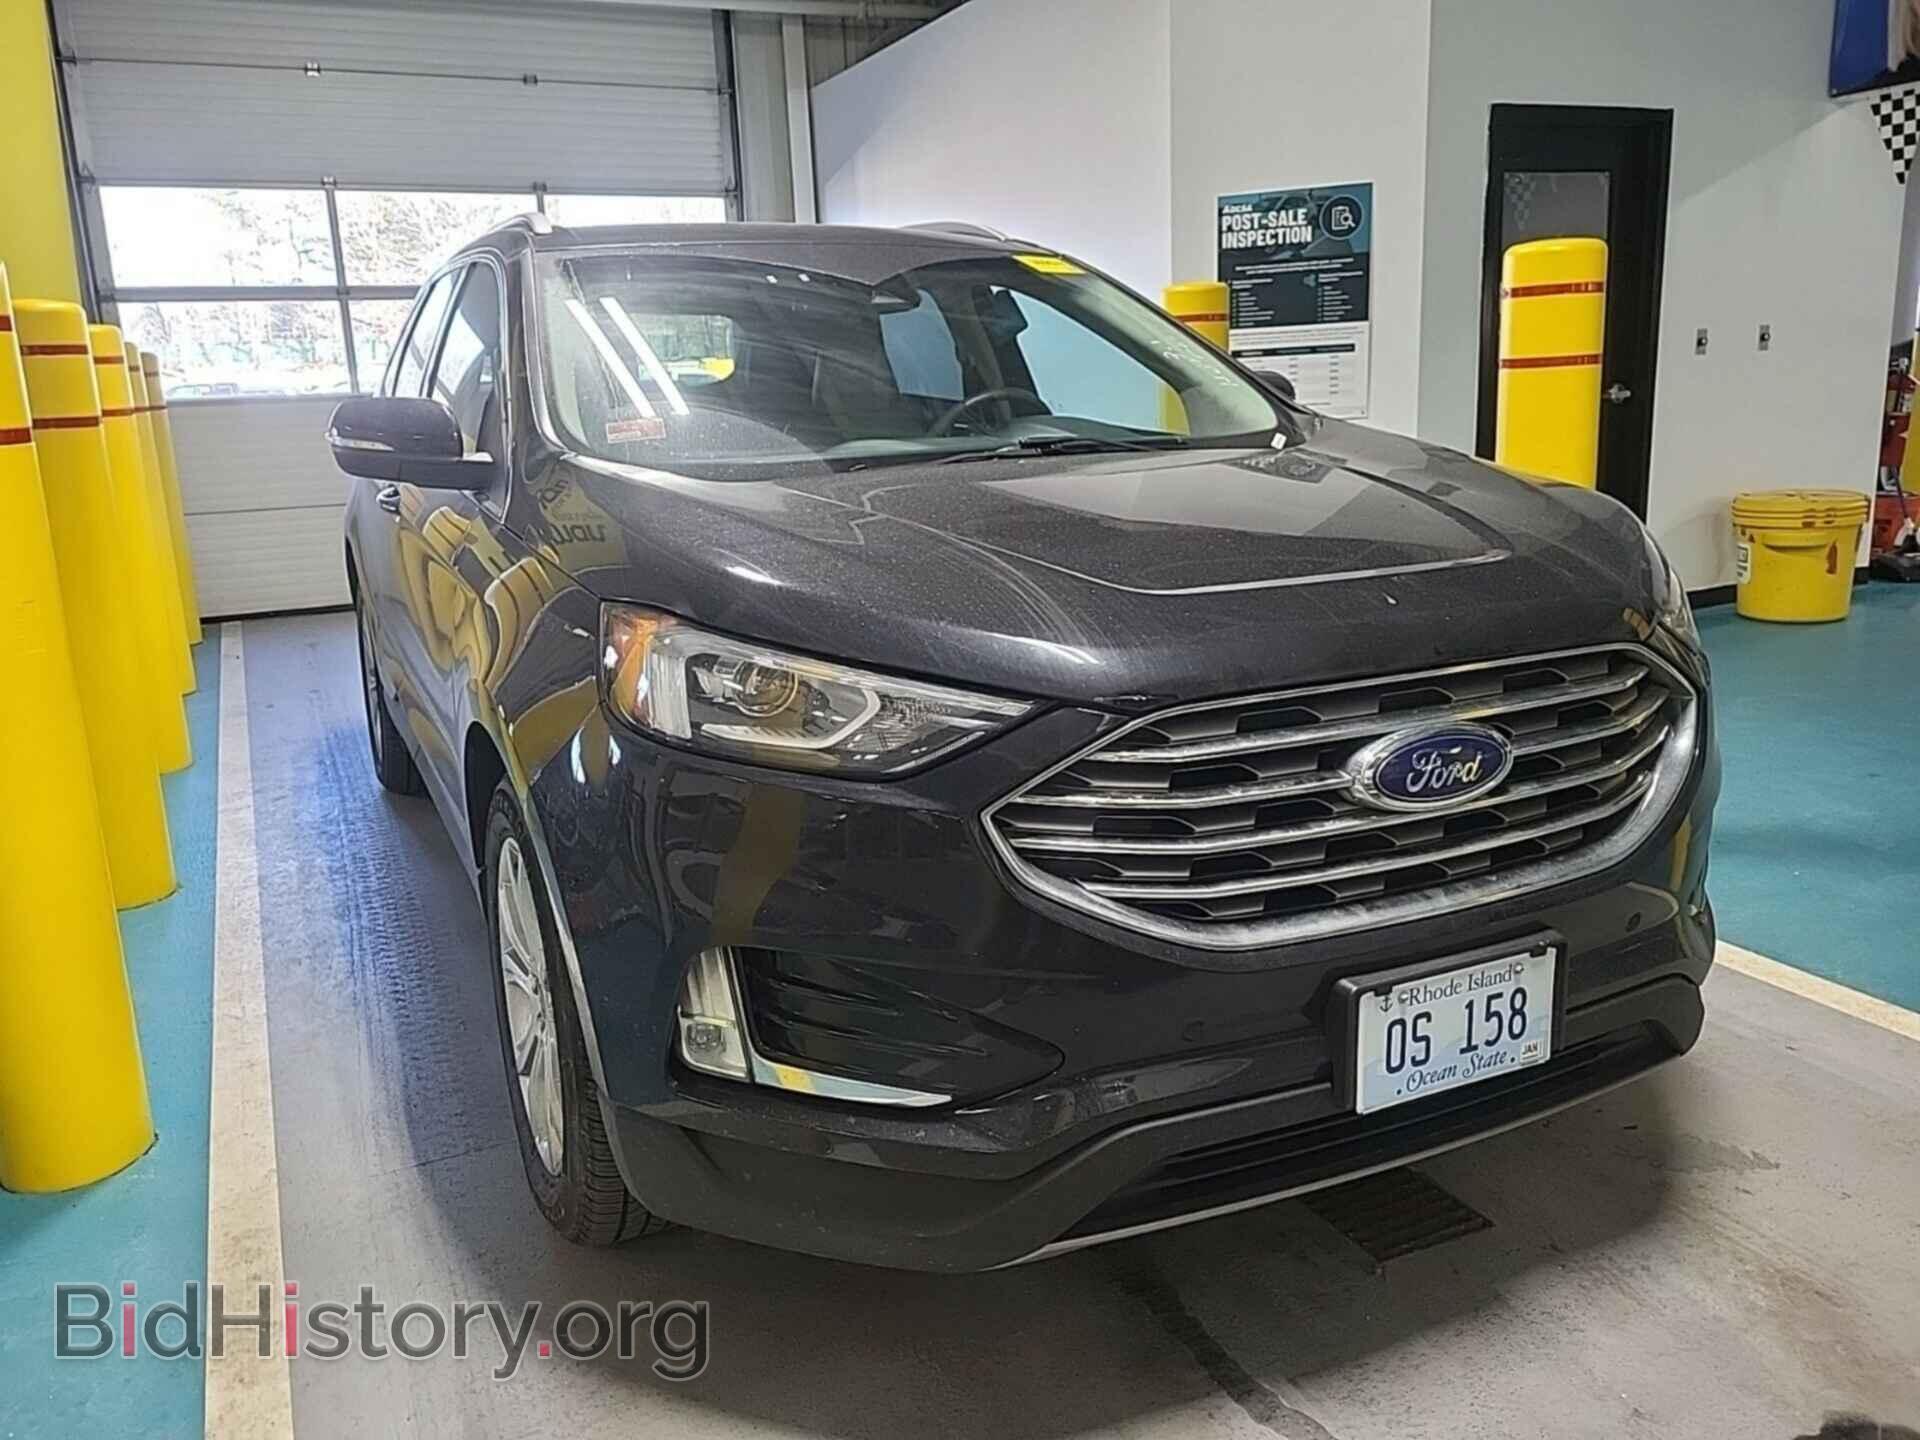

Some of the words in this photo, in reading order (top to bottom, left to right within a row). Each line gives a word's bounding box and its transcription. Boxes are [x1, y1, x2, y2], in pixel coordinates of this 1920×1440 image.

[1222, 208, 1308, 231] POST-SALE
[1222, 225, 1312, 249] INSPECTION
[1406, 747, 1483, 792] Ford
[1408, 978, 1462, 1006] Rhode
[1467, 963, 1513, 991] Island
[1459, 987, 1528, 1055] 158
[1406, 1064, 1457, 1092] Ocean
[1462, 1051, 1508, 1078] State
